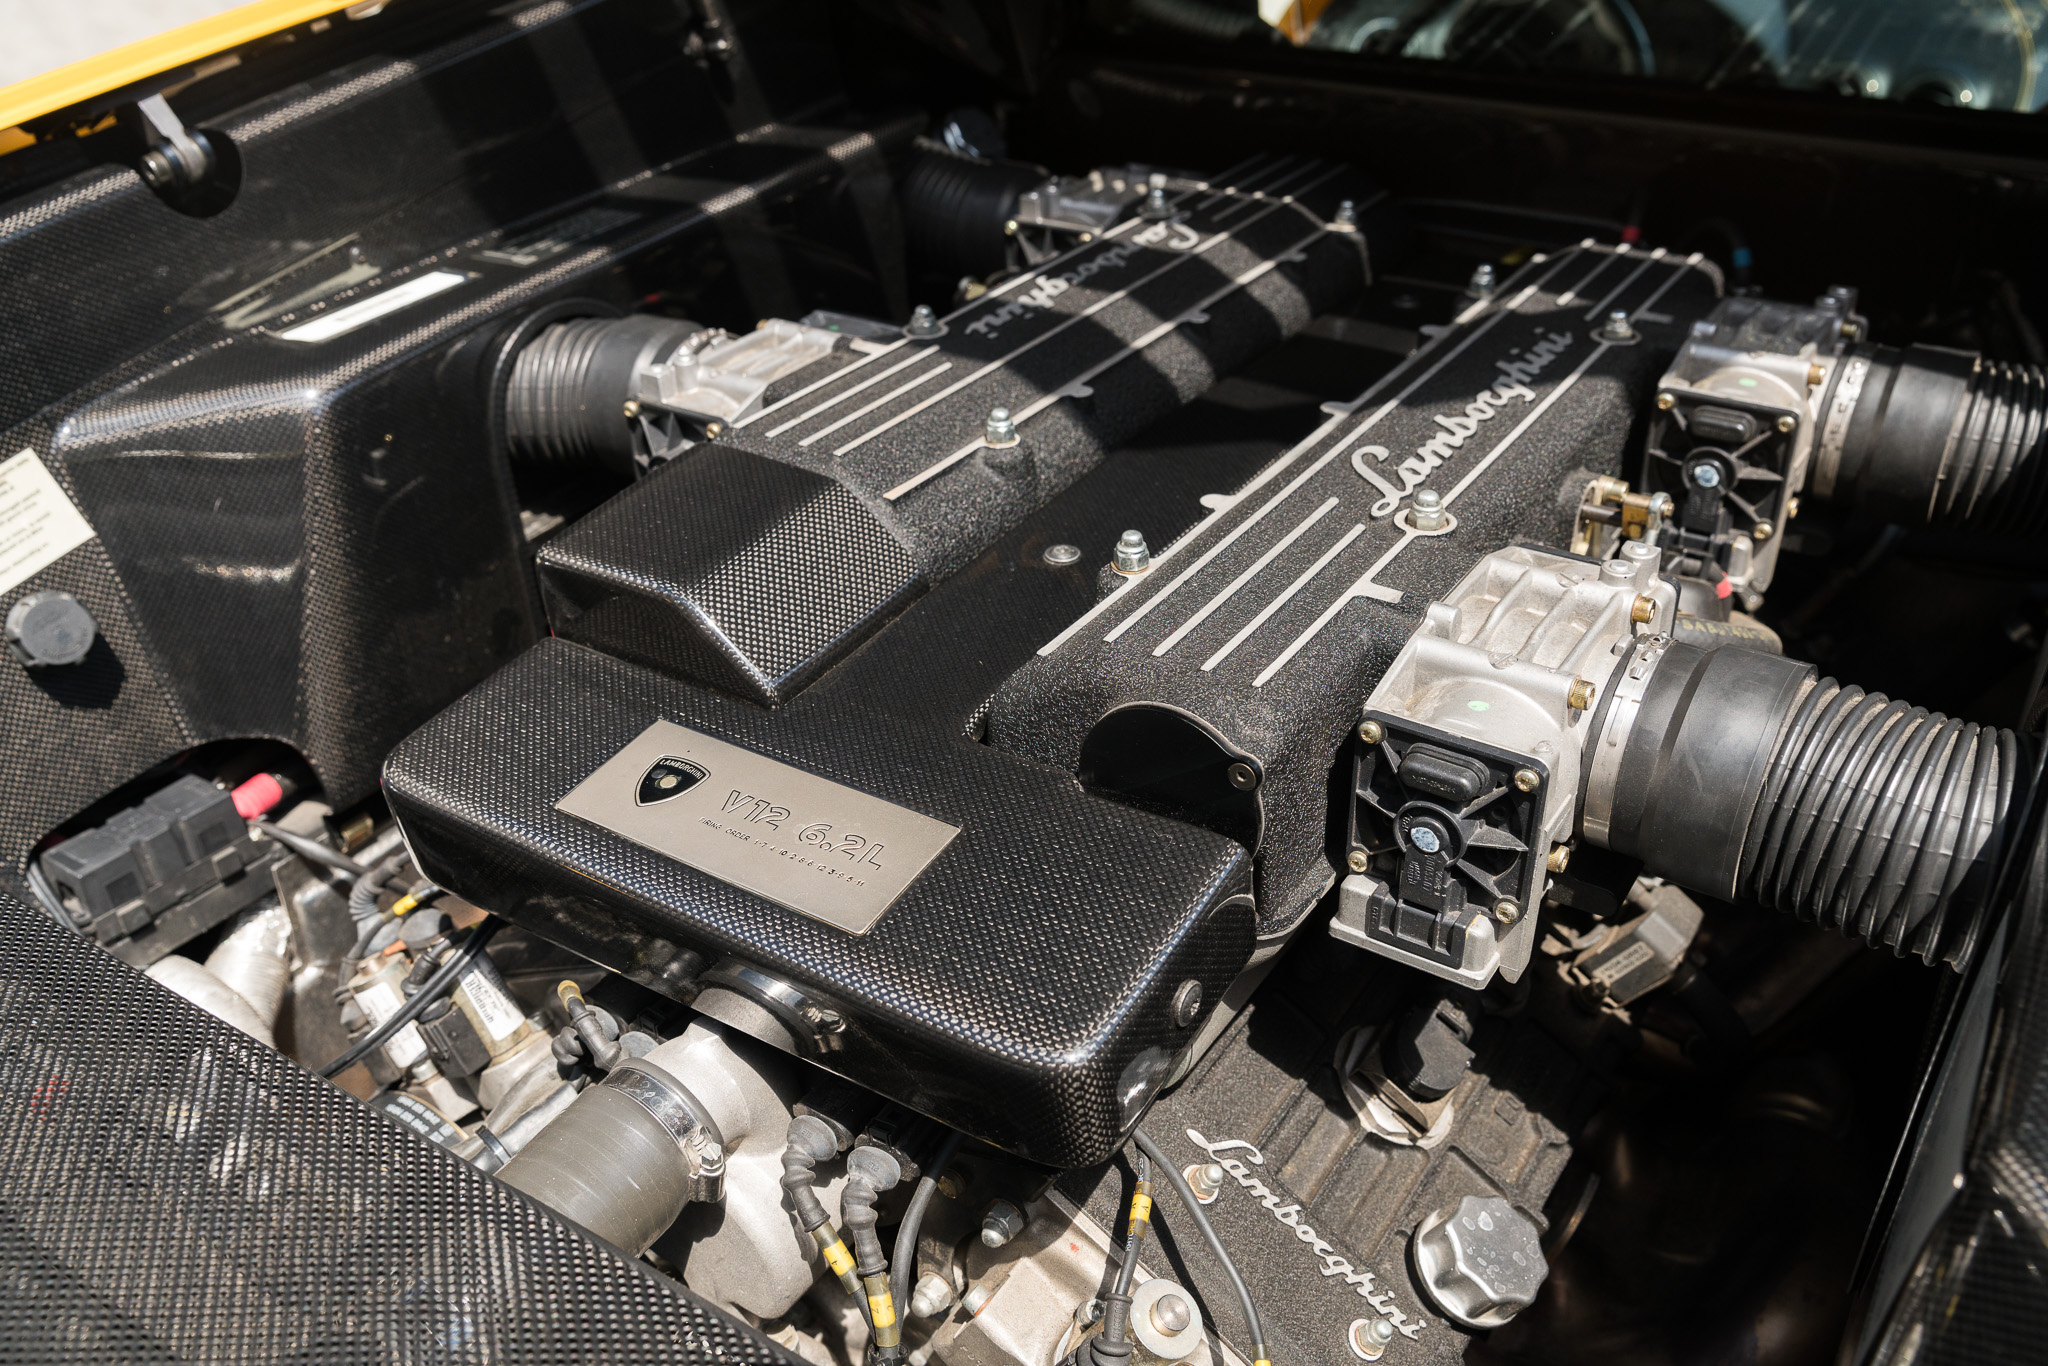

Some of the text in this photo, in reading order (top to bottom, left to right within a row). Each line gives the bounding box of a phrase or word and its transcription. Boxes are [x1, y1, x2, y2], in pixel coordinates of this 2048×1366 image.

[964, 211, 1200, 339] Lamborghini
[1351, 327, 1573, 516] Lamborghini
[660, 759, 704, 780] LAMBORGHINI
[698, 817, 722, 830] FIRING
[725, 827, 751, 841] ORDER
[721, 790, 885, 870] V12 6.2L
[1186, 1129, 1427, 1340] Lamborghini
